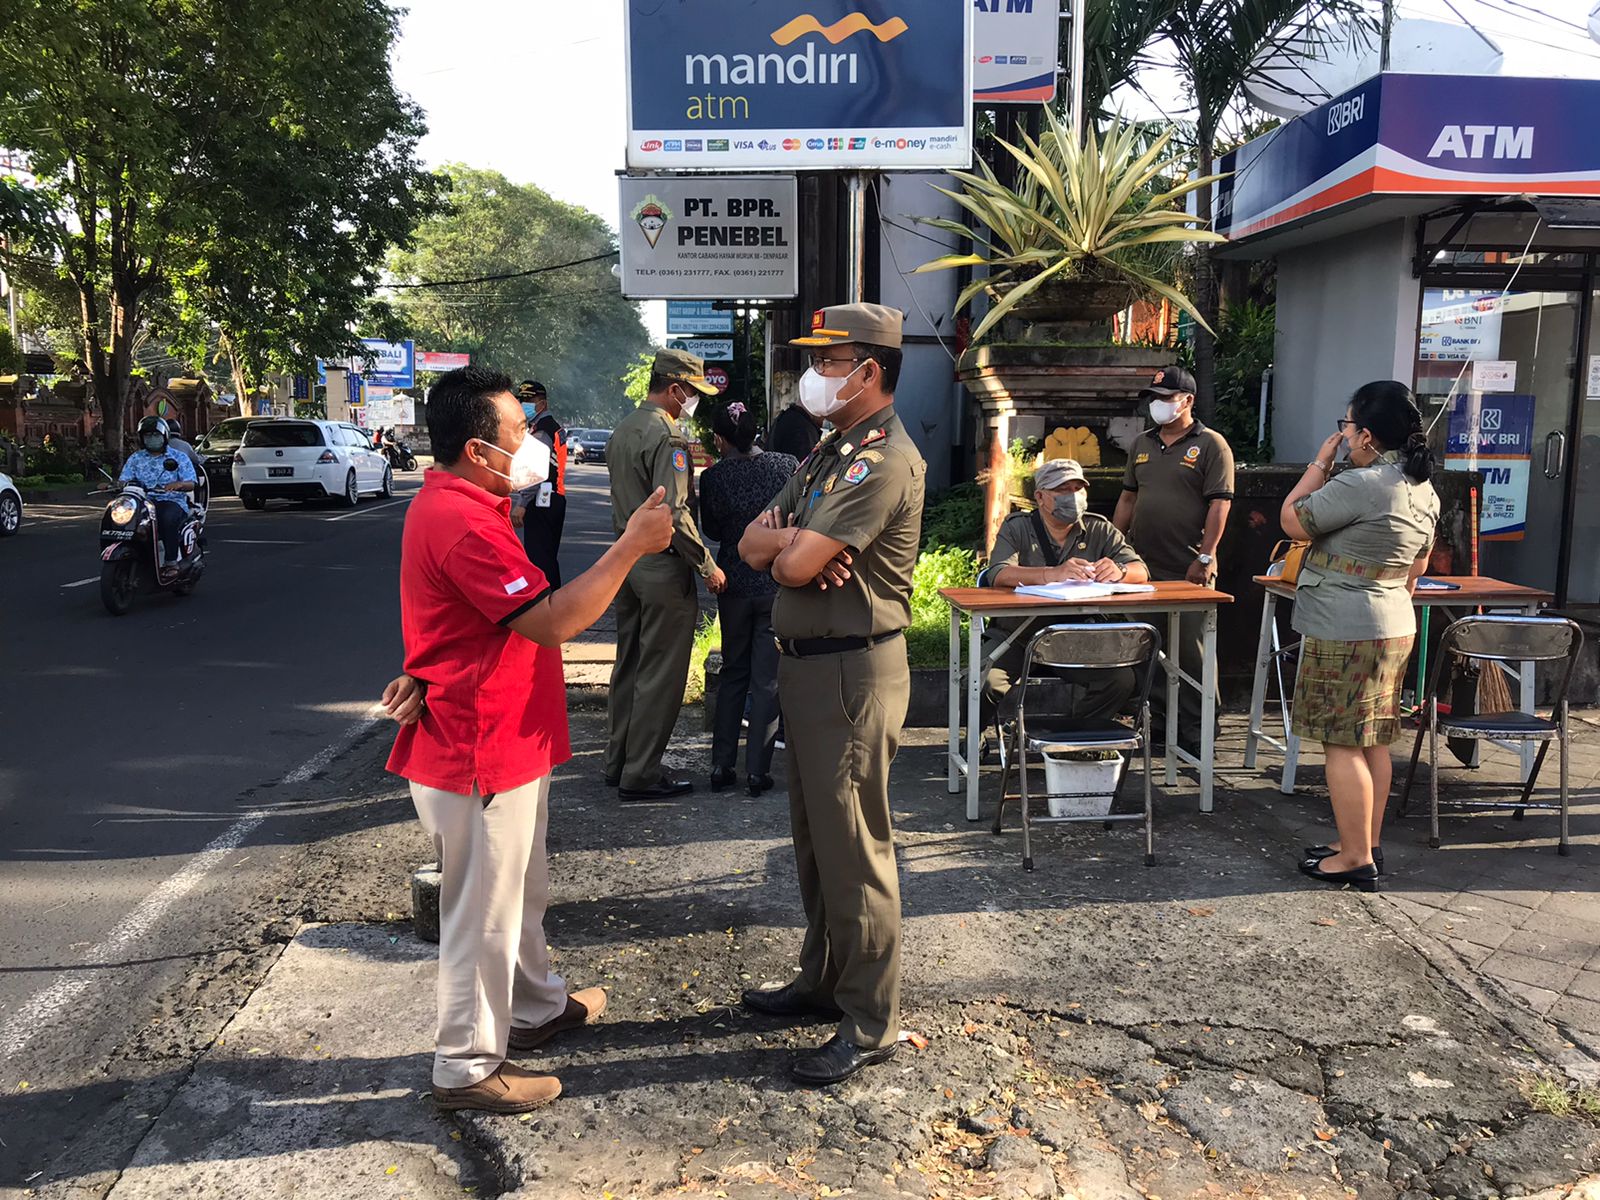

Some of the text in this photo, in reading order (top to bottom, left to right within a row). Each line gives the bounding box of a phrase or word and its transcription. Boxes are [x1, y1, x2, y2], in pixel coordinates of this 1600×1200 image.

[685, 42, 858, 85] mandiri
[686, 92, 749, 120] atm
[1341, 93, 1365, 128] BRI
[642, 142, 660, 150] Link
[733, 141, 754, 149] VISA
[874, 138, 926, 150] e-money
[1426, 125, 1535, 159] ATM
[684, 198, 780, 217] PT. BPR.
[677, 226, 788, 246] PENEBEL
[658, 268, 682, 277] (0361)
[683, 269, 713, 277] 231777,
[733, 268, 757, 277] (0361)
[1464, 316, 1482, 325] BNI
[704, 375, 726, 384] OYO
[1460, 433, 1520, 444] BANK BRI
[1481, 468, 1511, 484] TM
